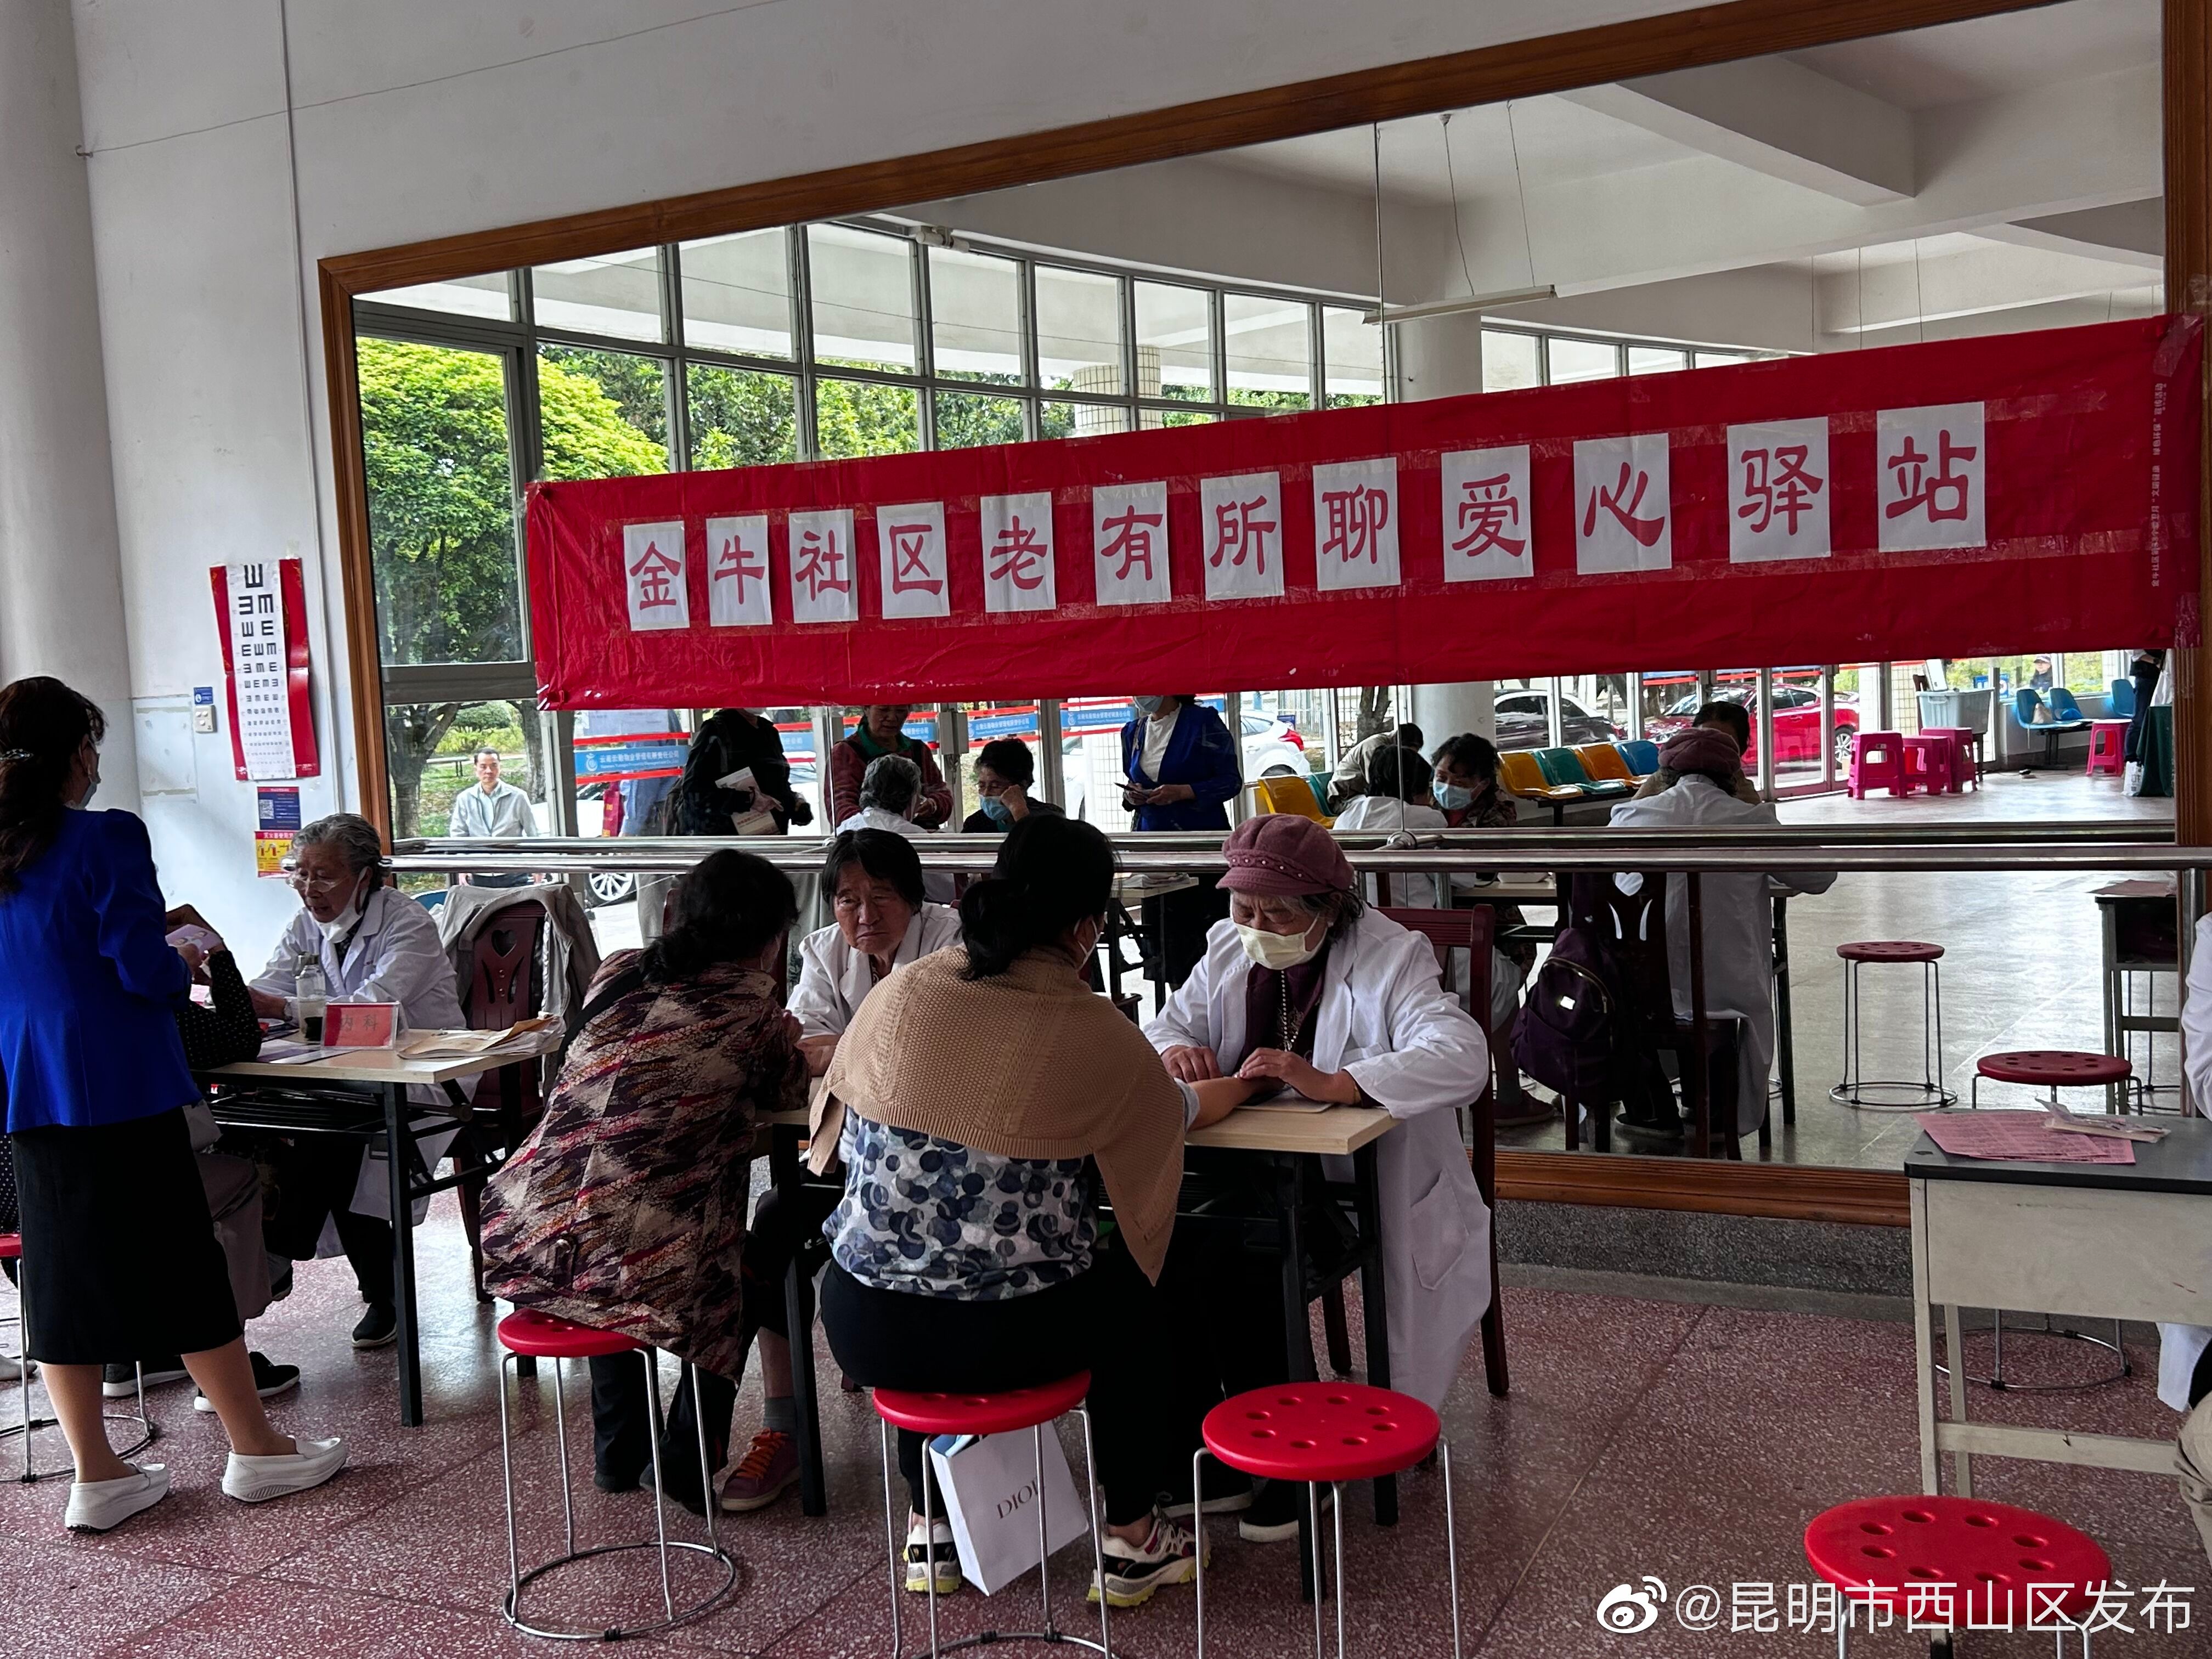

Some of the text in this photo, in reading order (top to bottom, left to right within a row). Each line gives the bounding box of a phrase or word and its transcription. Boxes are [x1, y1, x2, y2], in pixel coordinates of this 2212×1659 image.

[629, 429, 1977, 609] 金牛社区老有所聊爱心驿站
[340, 1014, 378, 1032] 内科
